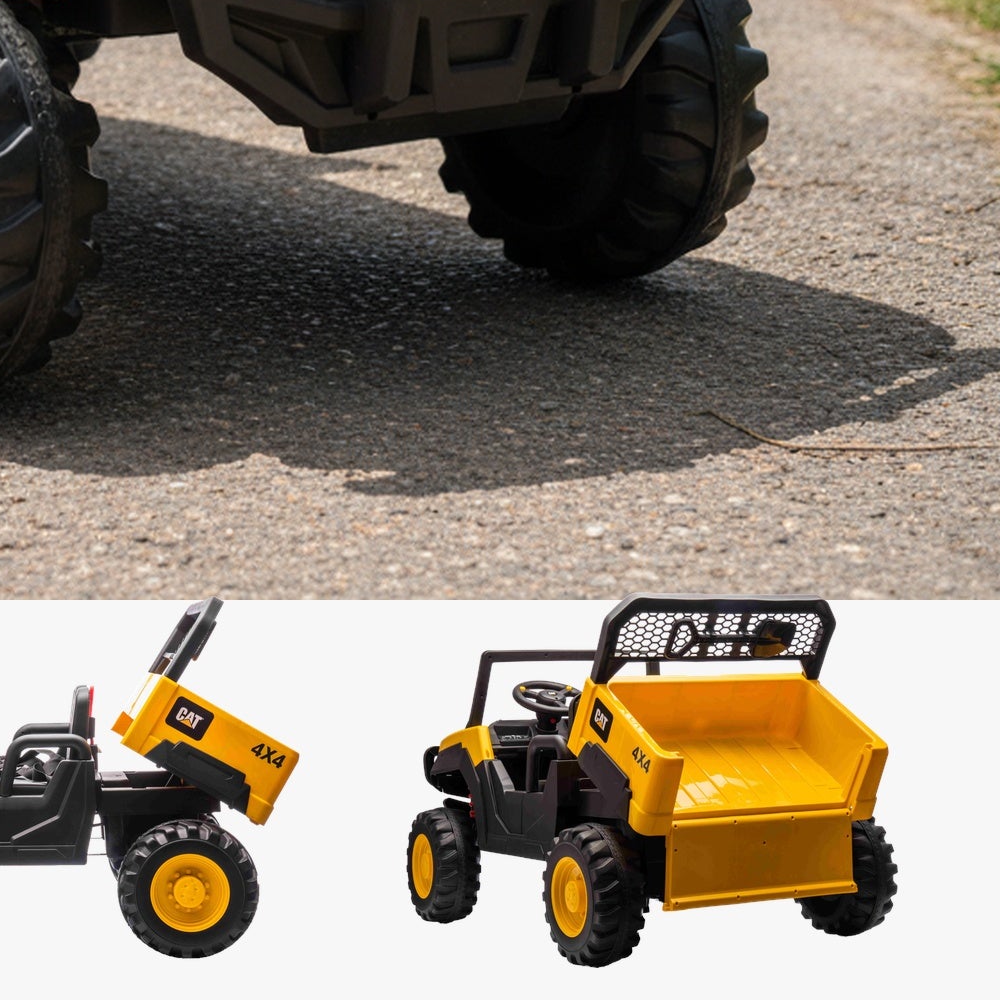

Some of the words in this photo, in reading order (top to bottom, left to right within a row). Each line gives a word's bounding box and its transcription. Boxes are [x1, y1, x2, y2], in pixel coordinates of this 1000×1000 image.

[175, 706, 204, 730] CAT
[594, 708, 609, 731] CAT
[251, 743, 287, 769] 4X4
[632, 746, 651, 774] 4X4
